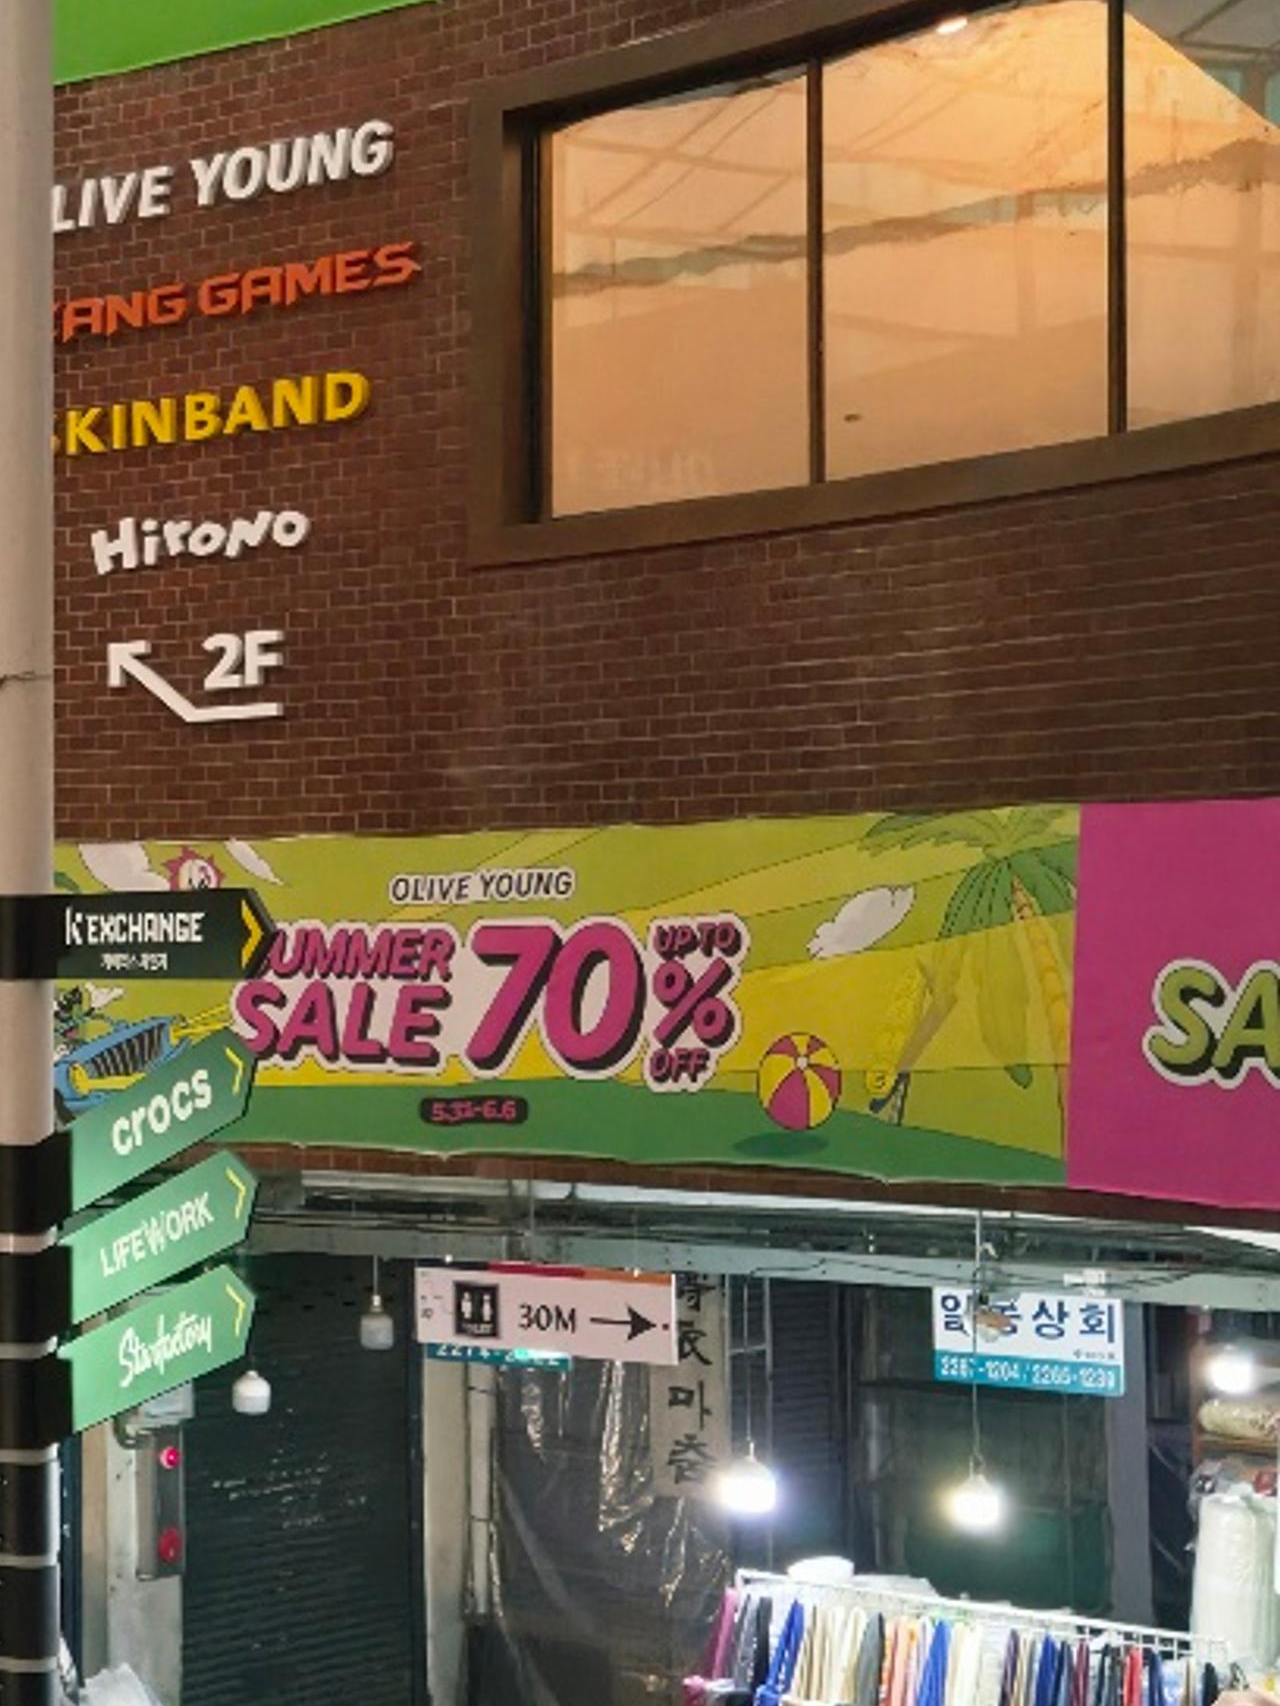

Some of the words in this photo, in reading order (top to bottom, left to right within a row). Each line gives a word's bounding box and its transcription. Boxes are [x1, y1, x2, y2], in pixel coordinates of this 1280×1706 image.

[190, 120, 394, 207] YOUNG
[54, 282, 189, 343] ANG
[197, 241, 423, 316] GAMES
[202, 630, 285, 692] 2F
[391, 875, 469, 902] OLIVE
[480, 870, 573, 898] YOUNG
[86, 911, 206, 944] EXCHANGE
[653, 923, 692, 958] UP
[697, 921, 741, 954] TO
[235, 979, 450, 1063] SALE
[466, 921, 646, 1070] 70
[650, 1049, 710, 1083] OFF
[111, 1068, 212, 1156] crocs
[100, 1192, 214, 1277] LIFEWORK
[518, 1304, 576, 1334] 30M
